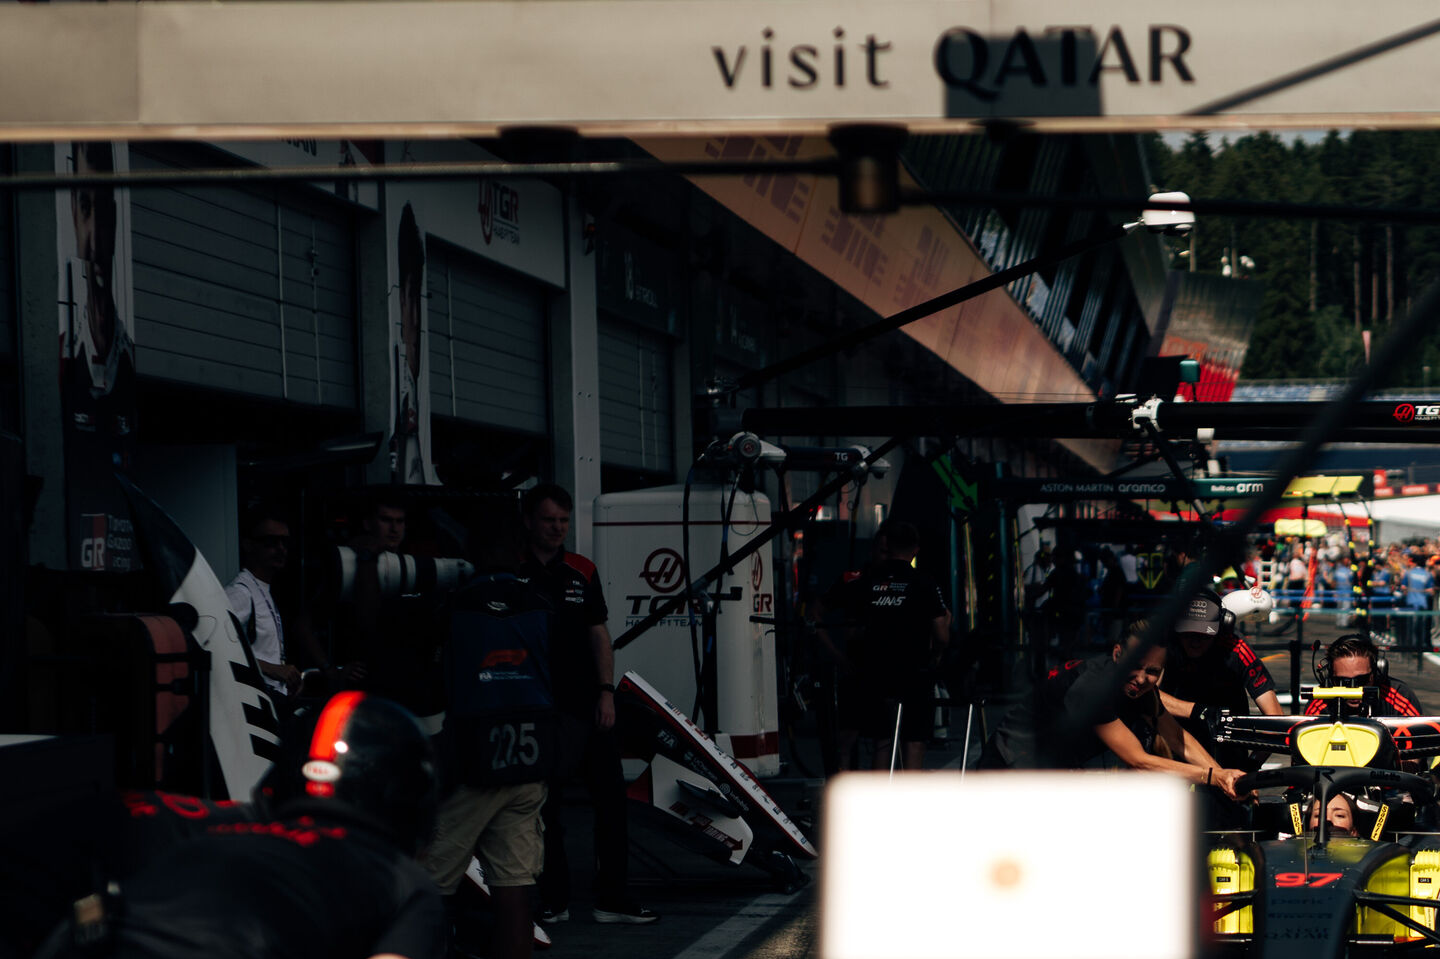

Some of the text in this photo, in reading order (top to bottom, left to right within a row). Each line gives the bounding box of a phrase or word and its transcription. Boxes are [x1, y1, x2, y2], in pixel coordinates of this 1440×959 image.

[712, 23, 1196, 102] visit QATAR
[1040, 483, 1167, 493] ASTON MARTIN aramco
[1236, 483, 1264, 493] arm
[81, 537, 105, 567] GR
[872, 596, 907, 606] HAAS
[488, 722, 539, 770] 225
[657, 729, 678, 749] FIA
[1315, 768, 1336, 783] R
[1274, 872, 1344, 888] 97
